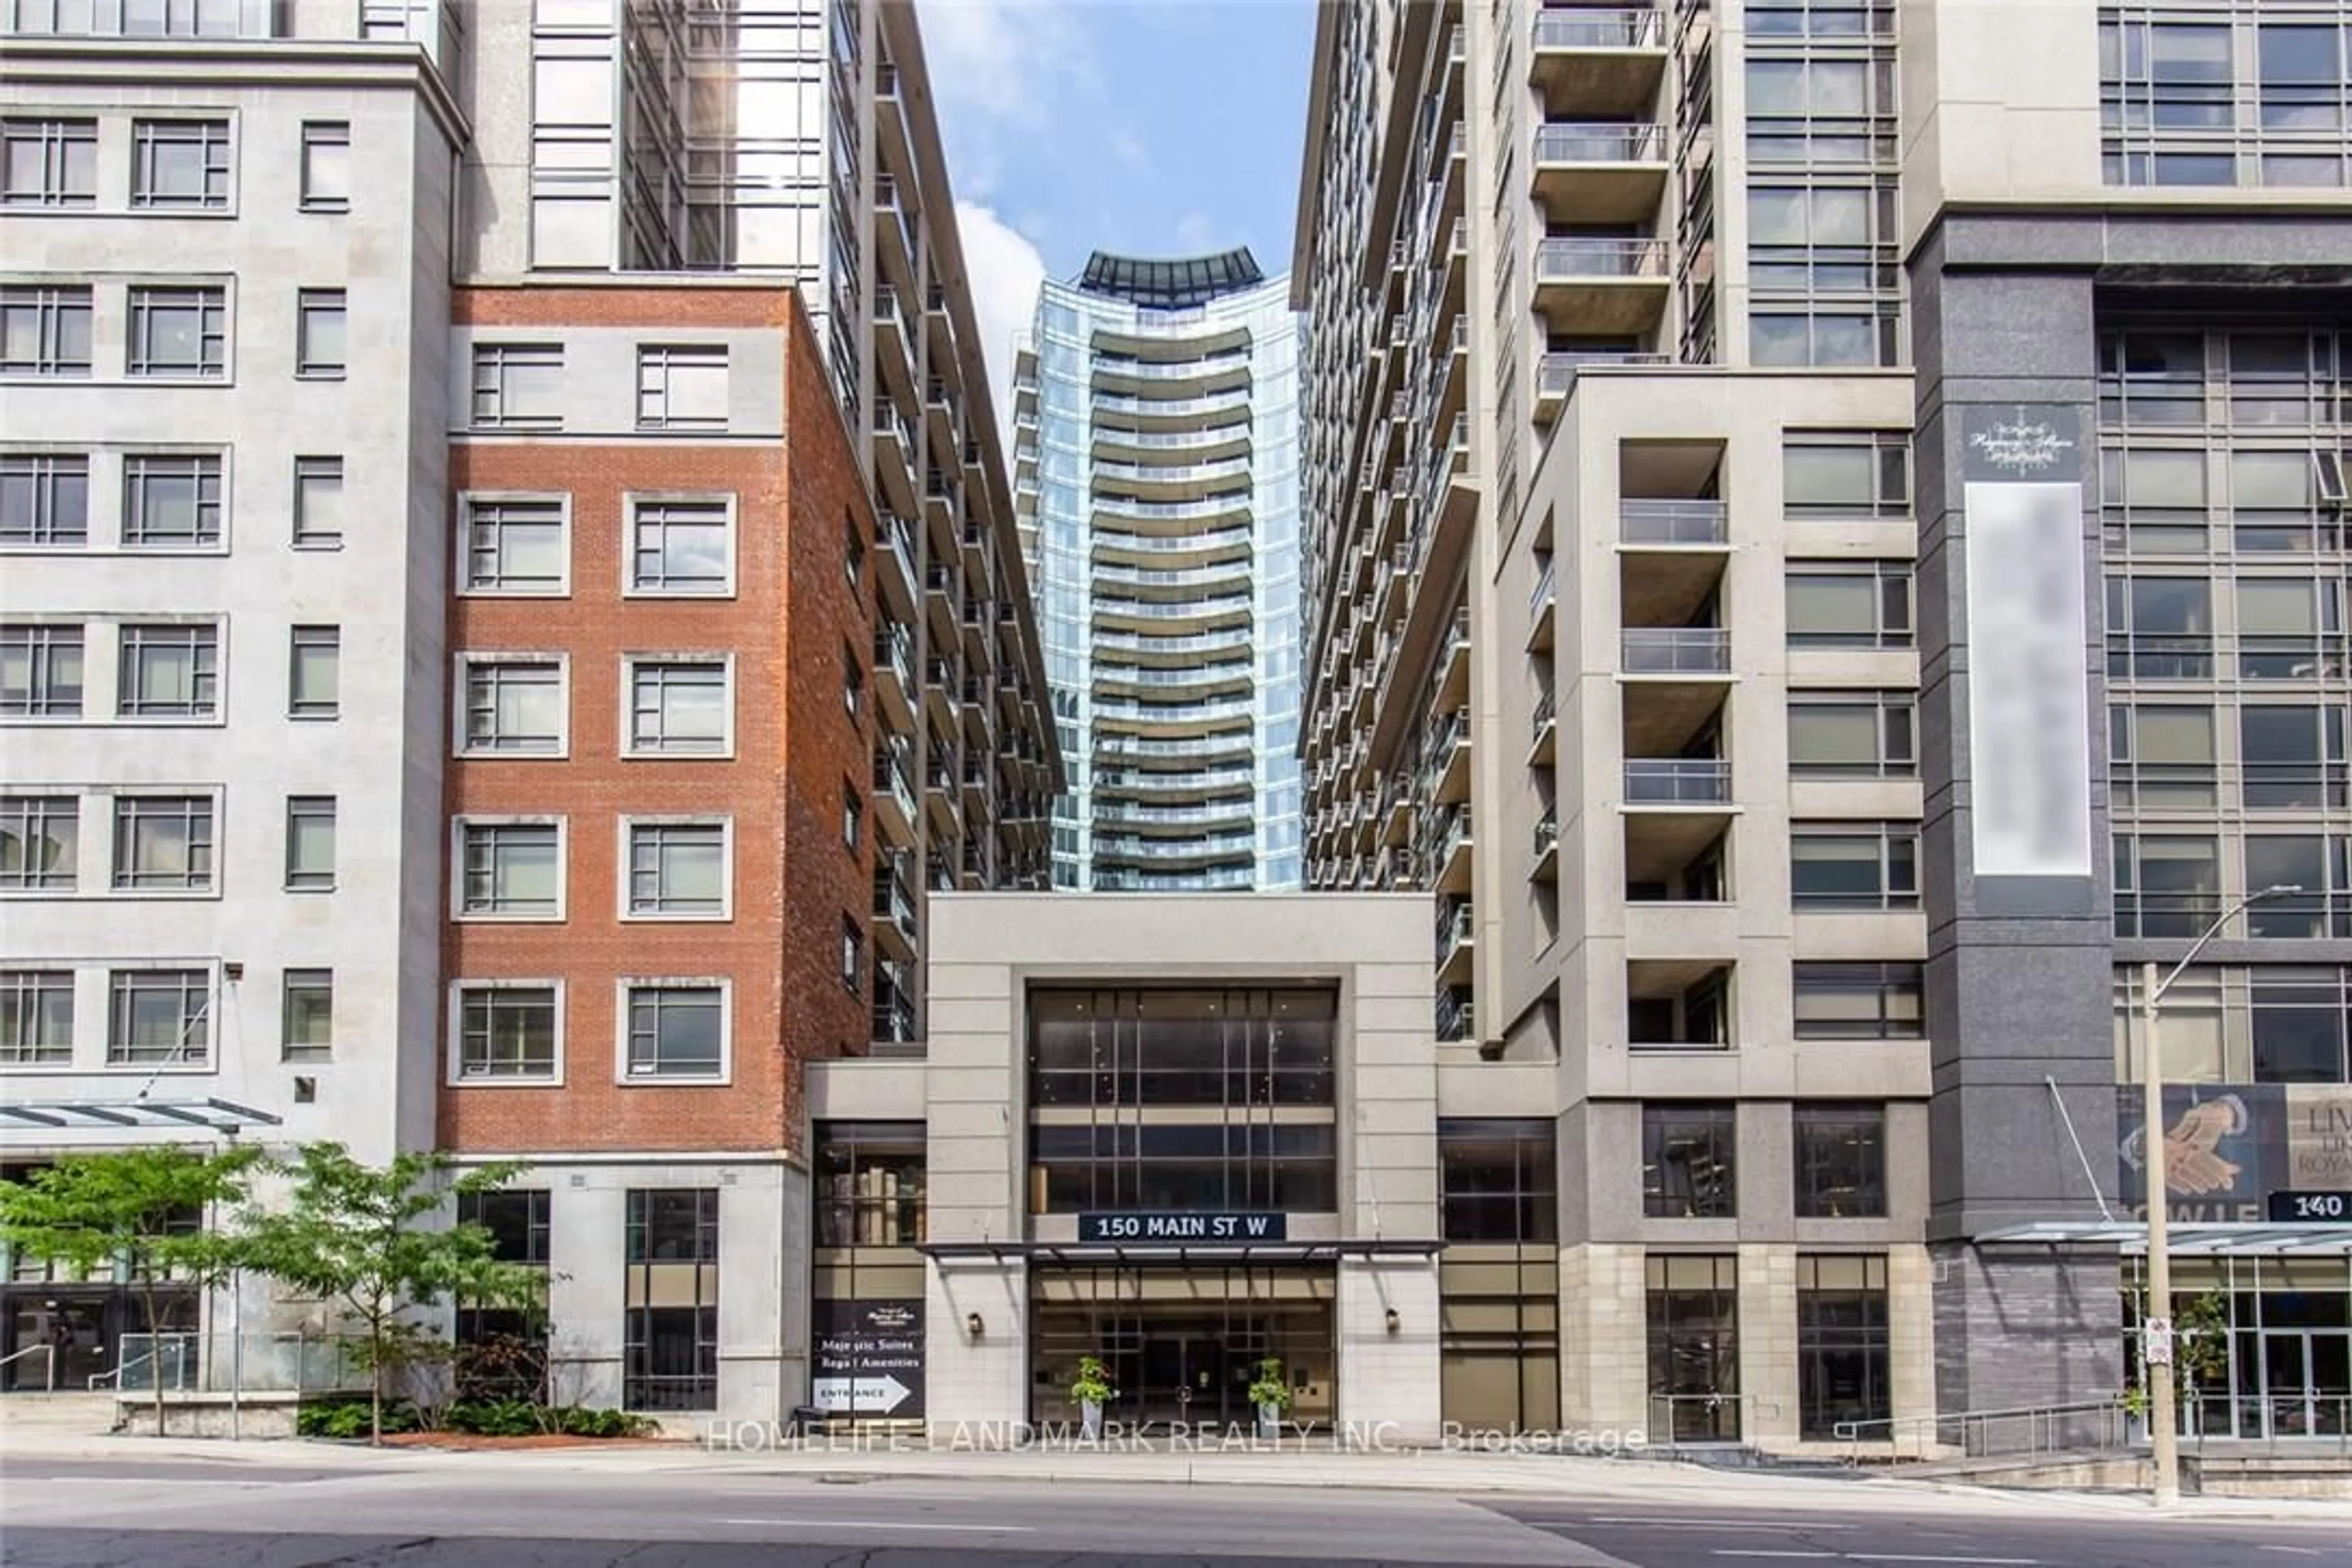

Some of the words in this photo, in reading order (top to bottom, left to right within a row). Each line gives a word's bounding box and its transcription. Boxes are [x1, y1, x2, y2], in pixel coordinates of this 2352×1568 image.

[2294, 1196, 2343, 1216] 140
[1098, 1217, 1140, 1236] 150
[1147, 1217, 1205, 1236] MAIN
[1213, 1217, 1238, 1236] ST
[1247, 1217, 1268, 1236] W
[878, 1339, 913, 1351] Suites
[861, 1357, 919, 1368] Amenities
[820, 1389, 884, 1398] ENTRANCE
